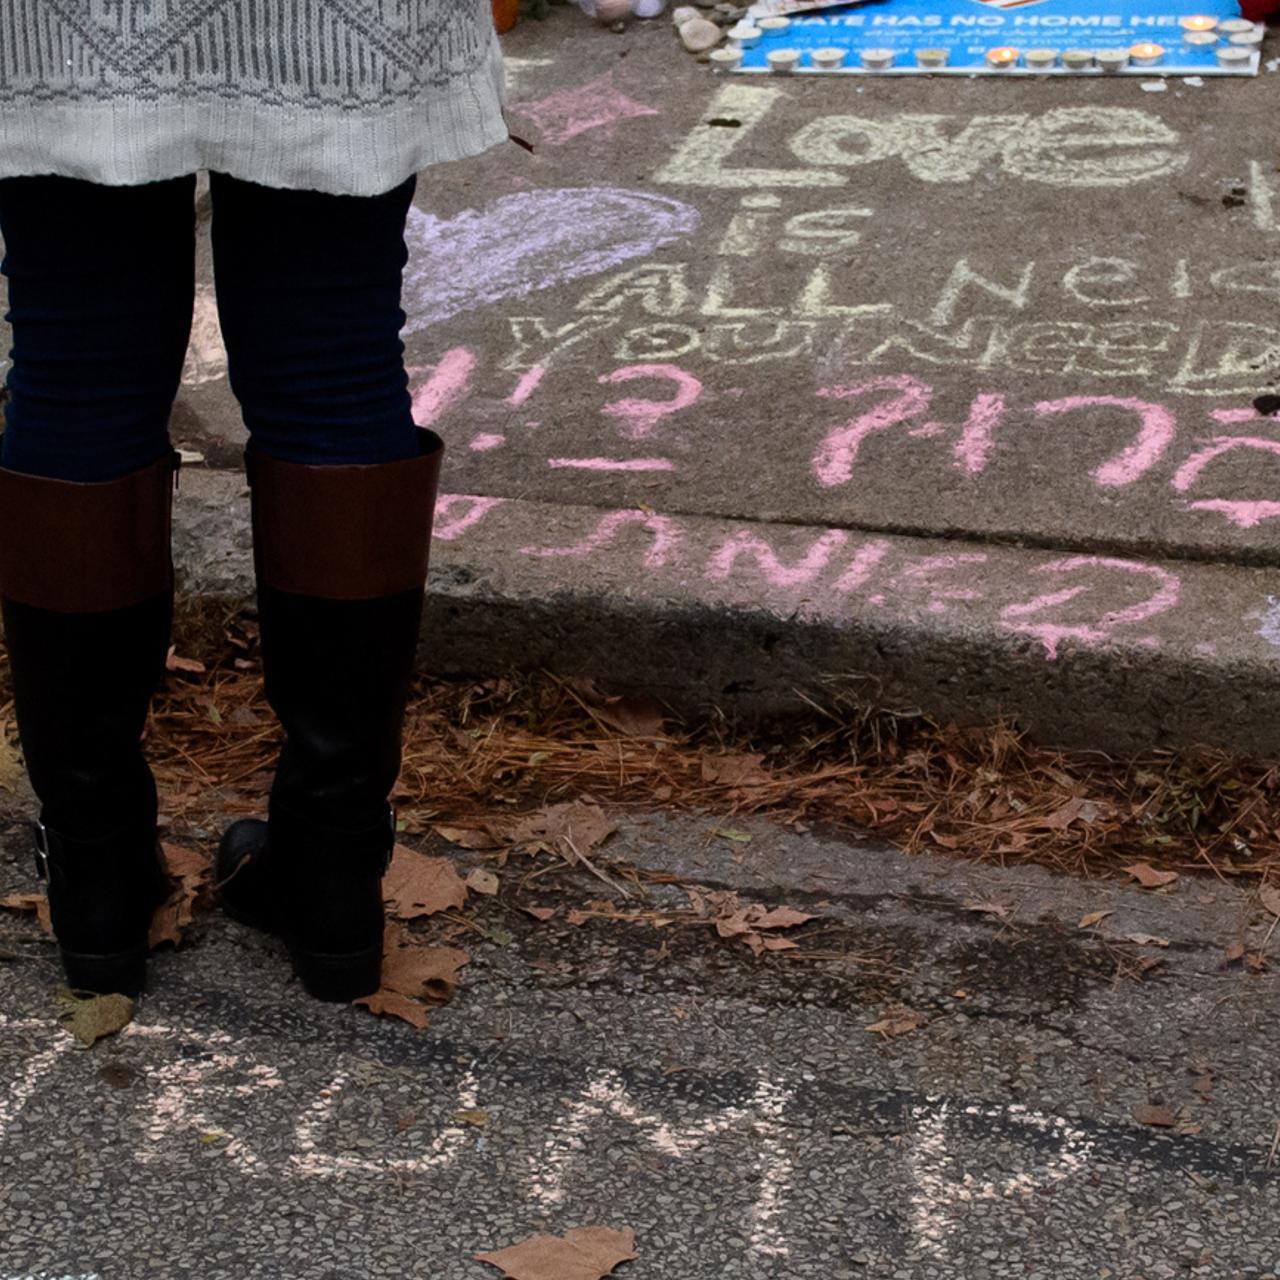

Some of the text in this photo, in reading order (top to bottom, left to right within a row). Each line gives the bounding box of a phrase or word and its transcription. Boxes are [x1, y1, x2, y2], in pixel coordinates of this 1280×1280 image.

[872, 15, 944, 28] HAS
[947, 15, 1008, 28] NO
[1013, 15, 1124, 28] HOME
[653, 83, 1192, 188] Love
